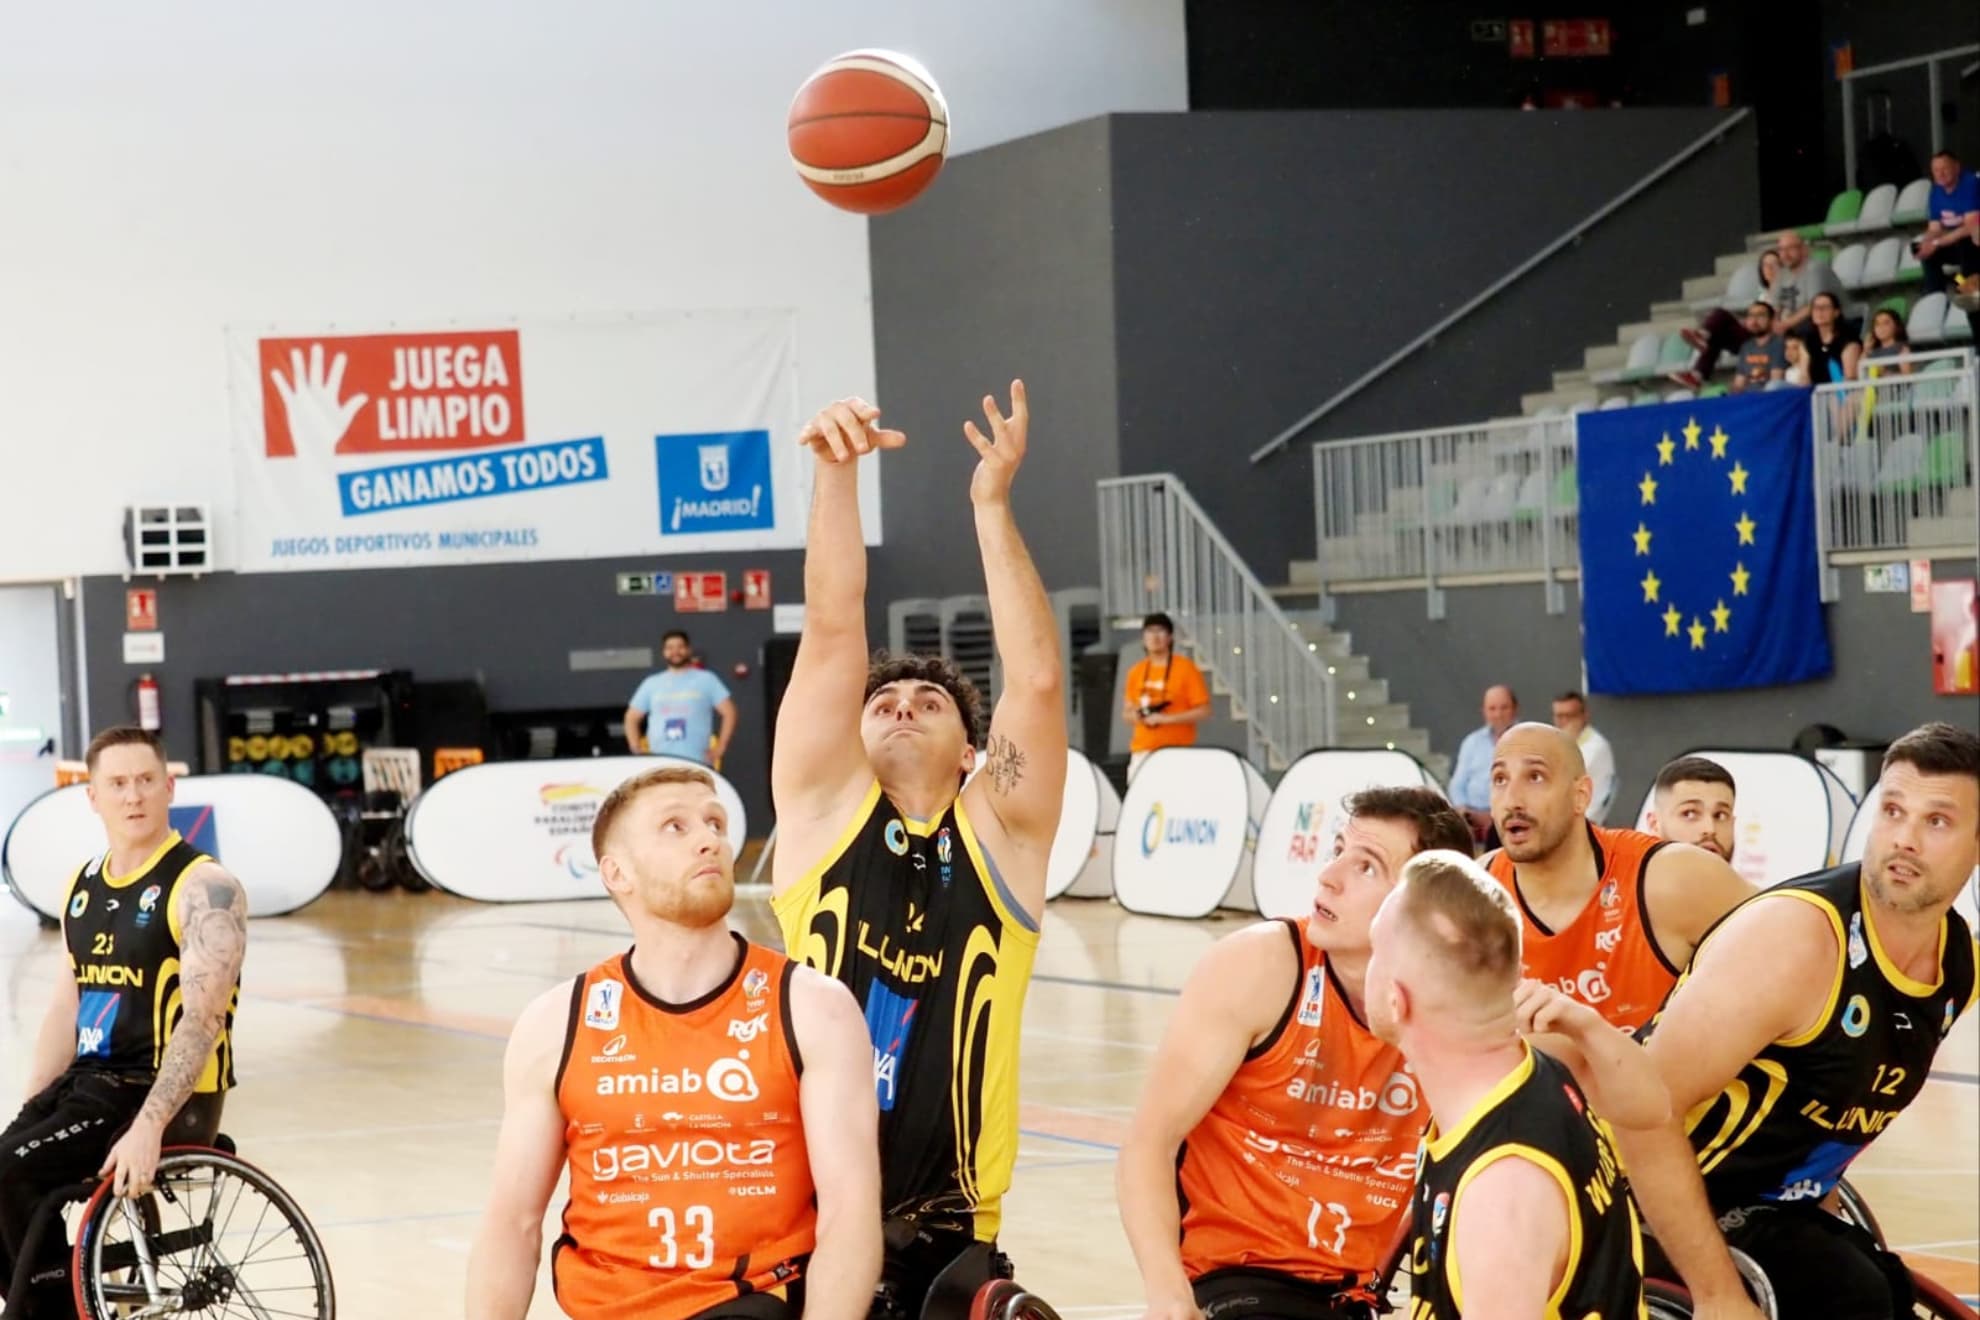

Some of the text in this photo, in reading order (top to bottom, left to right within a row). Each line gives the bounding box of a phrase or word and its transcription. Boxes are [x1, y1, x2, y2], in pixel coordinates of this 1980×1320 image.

[389, 344, 509, 391] JUEGA
[377, 393, 511, 440] LIMPIO
[350, 444, 597, 510] GANAMOS TODOS
[271, 528, 538, 557] JUEGOS DEPORTIVOS MUNICIPALES
[596, 1067, 702, 1095] amiab
[1871, 1064, 1907, 1095] 12
[593, 1139, 777, 1181] gaviota
[651, 1171, 670, 1182] Sun
[673, 1171, 680, 1181] &
[683, 1169, 721, 1181] Shutter
[737, 1186, 777, 1196] UCLM
[648, 1205, 714, 1269] 33
